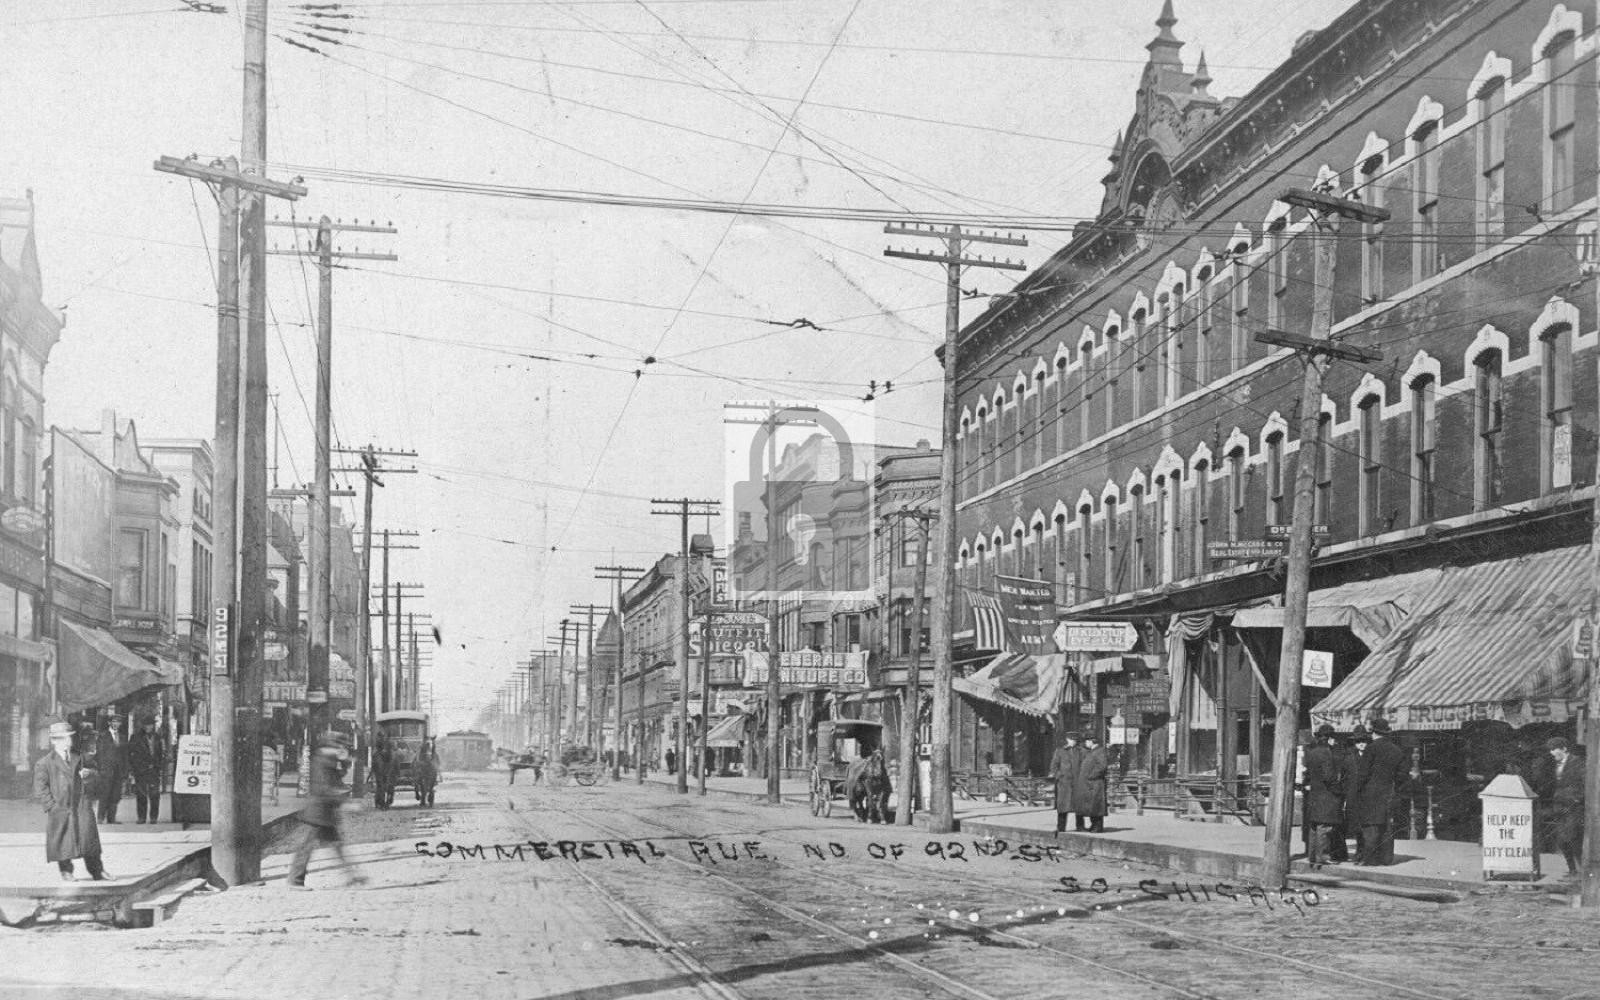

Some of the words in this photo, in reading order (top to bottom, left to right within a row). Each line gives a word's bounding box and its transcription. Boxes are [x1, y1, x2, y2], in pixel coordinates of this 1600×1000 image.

[1021, 634, 1047, 645] ARMY
[750, 669, 839, 684] FUNITURE
[187, 776, 199, 787] 9
[1487, 814, 1507, 826] HELP
[1509, 814, 1531, 826] KEEP
[1499, 828, 1515, 840] THE
